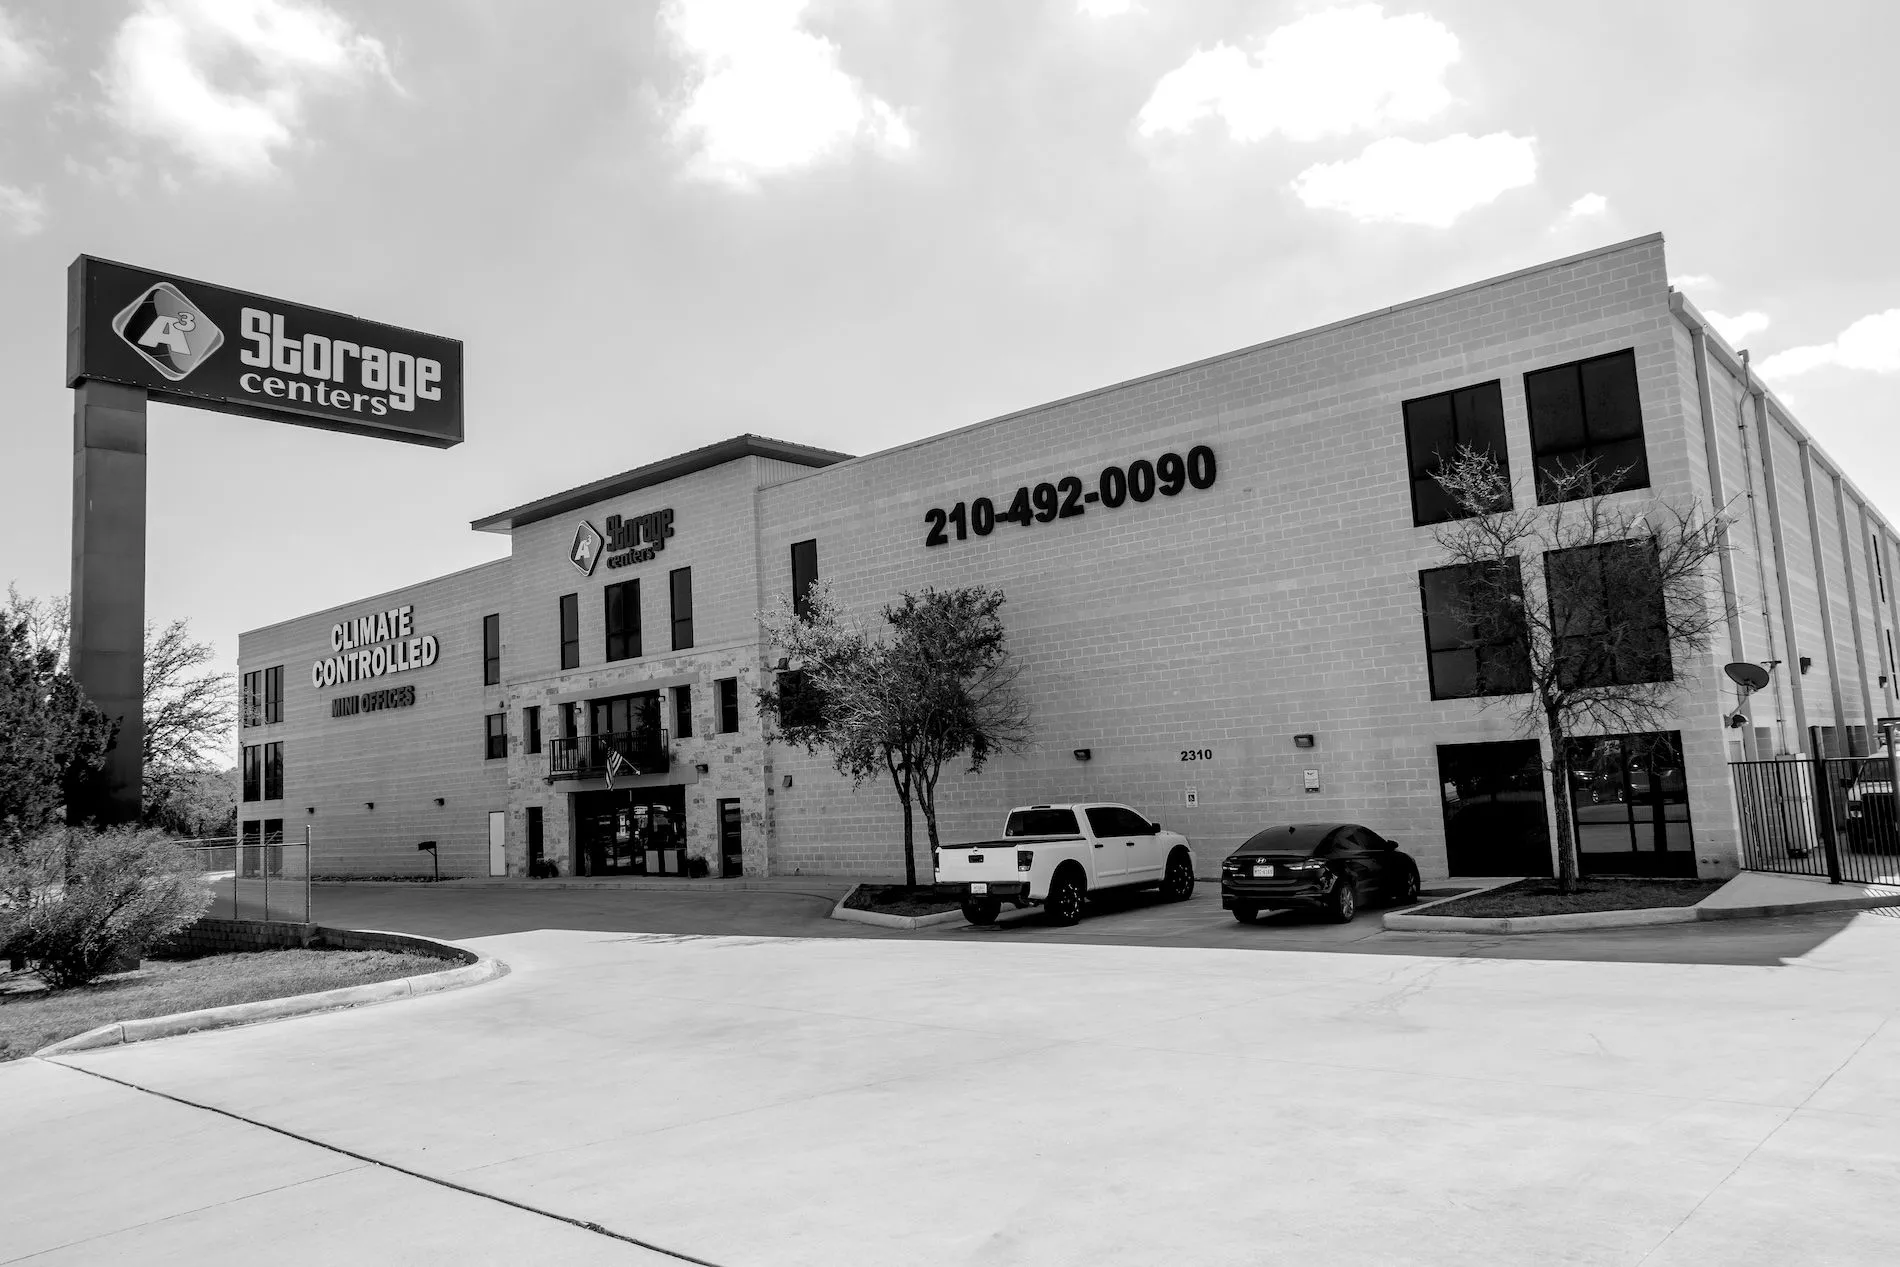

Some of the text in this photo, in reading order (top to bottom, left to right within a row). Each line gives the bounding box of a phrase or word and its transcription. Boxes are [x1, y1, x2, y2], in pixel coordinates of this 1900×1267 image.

[240, 307, 441, 412] Storage
[239, 372, 388, 416] centers
[924, 445, 1217, 547] 210-492-0090
[606, 508, 674, 551] Storage
[606, 547, 655, 569] centers
[331, 604, 414, 652] CLIMATE
[312, 635, 440, 689] CONTROLLED
[331, 685, 415, 717] MINI OFFICES
[1180, 749, 1213, 762] 2310
